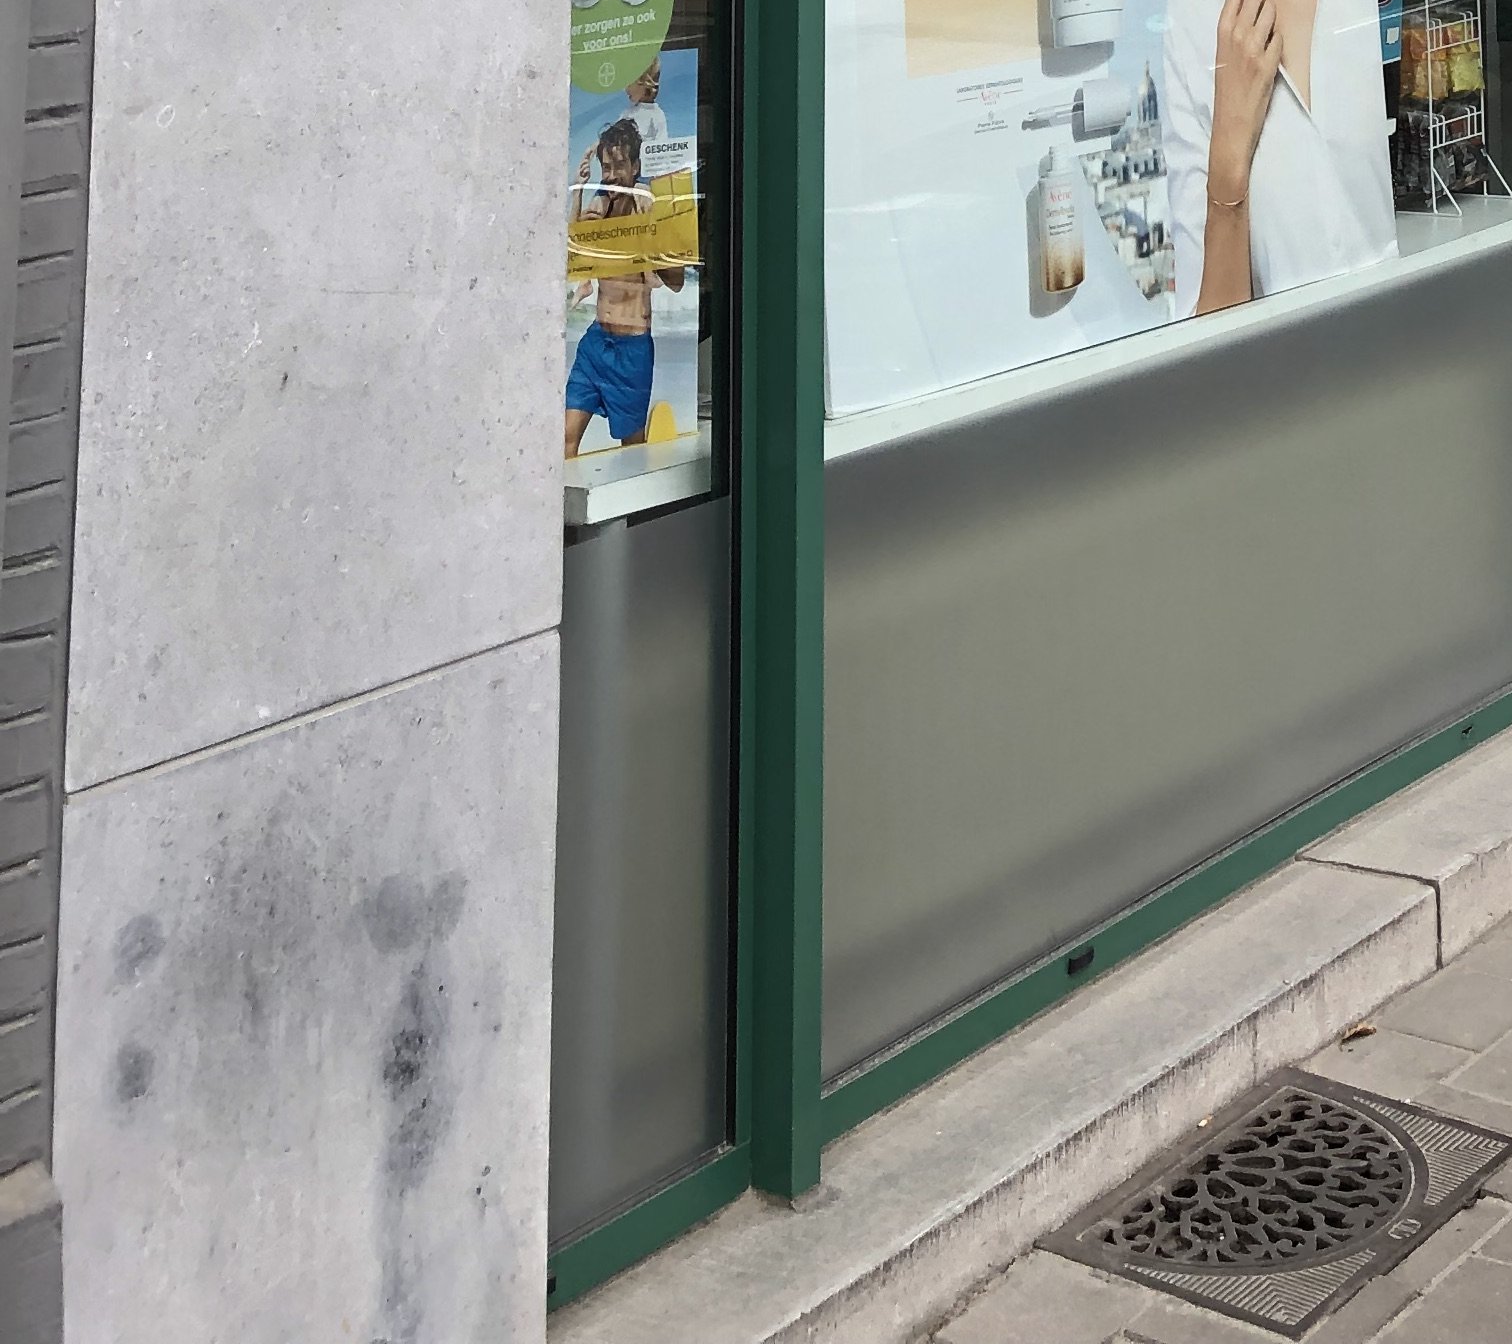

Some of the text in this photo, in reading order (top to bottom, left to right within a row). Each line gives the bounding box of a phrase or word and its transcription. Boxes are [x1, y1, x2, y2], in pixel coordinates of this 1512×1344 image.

[584, 17, 621, 34] zorgen
[622, 15, 635, 26] ze
[636, 8, 656, 23] ook
[583, 29, 633, 52] voor ons!
[644, 141, 689, 155] GESCHENK
